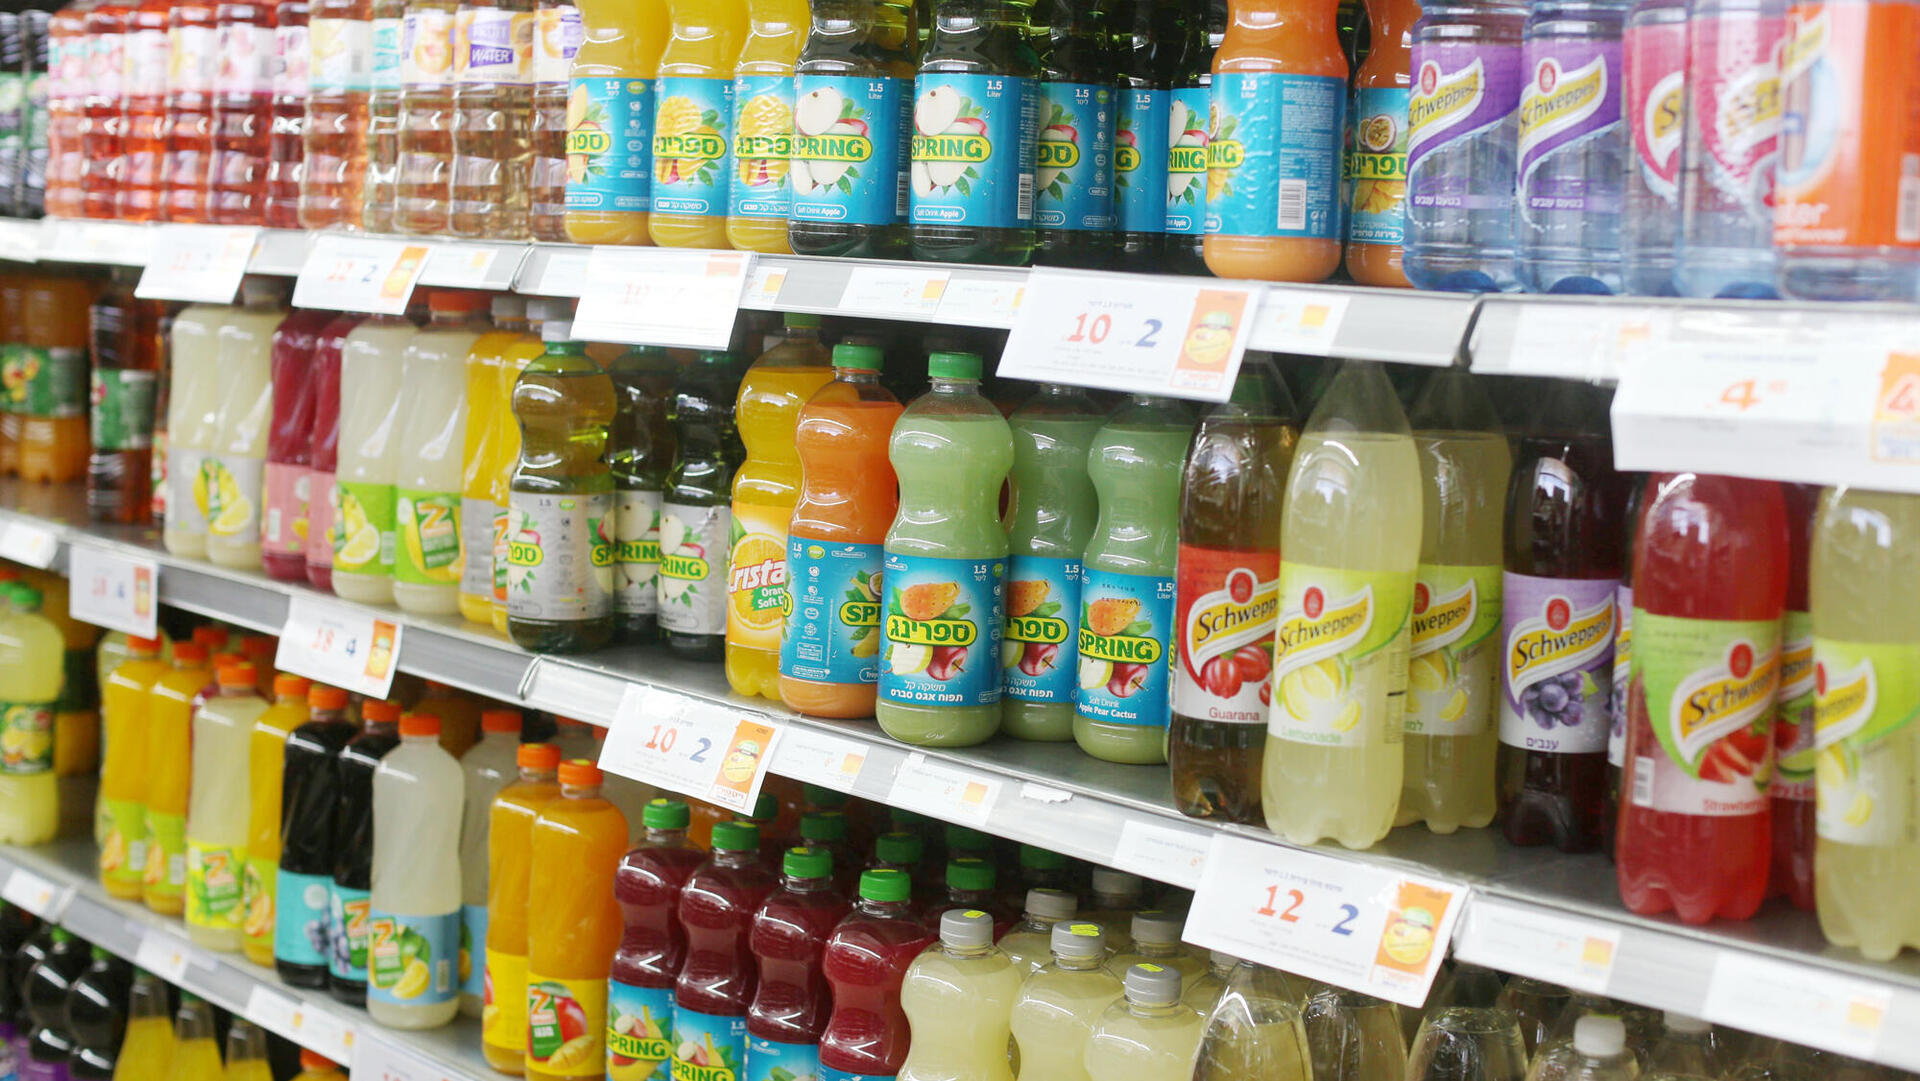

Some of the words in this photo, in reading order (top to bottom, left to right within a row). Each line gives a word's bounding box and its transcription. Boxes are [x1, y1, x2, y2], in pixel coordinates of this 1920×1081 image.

[472, 47, 509, 64] WATER
[868, 82, 884, 93] 1.5
[986, 80, 1003, 91] 1.5
[1241, 79, 1259, 91] 1.5
[1075, 88, 1090, 98] 1.5
[1135, 94, 1151, 103] 1.5
[655, 134, 719, 155] ספרינג
[792, 139, 864, 158] SPRING
[912, 138, 983, 158] SPRING
[821, 207, 841, 217] Apple
[939, 209, 960, 219] Apple
[1067, 312, 1113, 345] 10
[1134, 318, 1164, 348] 2
[1720, 378, 1761, 411] 4
[793, 542, 803, 552] 1.5
[973, 564, 988, 575] 1.5
[1064, 564, 1080, 574] 1.5
[974, 574, 988, 582] ליטר
[1065, 574, 1079, 582] ליטר
[1157, 582, 1172, 592] 1.5
[757, 597, 778, 609] Soft
[890, 618, 971, 643] ספרינג
[1278, 612, 1363, 657] Schweppes
[1079, 633, 1154, 660] SPRING
[1515, 621, 1609, 669] Schweppes
[921, 681, 947, 692] משקה
[1008, 686, 1028, 697] אגס
[890, 688, 915, 699] סברס
[915, 690, 938, 701] אגס
[938, 692, 964, 703] תפוח
[1028, 689, 1055, 698] תפוח
[1100, 697, 1120, 708] Drink
[1079, 702, 1093, 714] Apple
[1093, 704, 1110, 716] Pear
[1110, 706, 1138, 719] Cactus
[1208, 706, 1261, 722] Guarana
[1282, 727, 1343, 744] Lemonade
[644, 724, 678, 753] 10
[689, 737, 712, 763] 2
[1526, 736, 1560, 750] ענבים
[1257, 884, 1305, 923] 12
[1330, 904, 1360, 937] 2
[731, 1020, 746, 1030] 1.5
